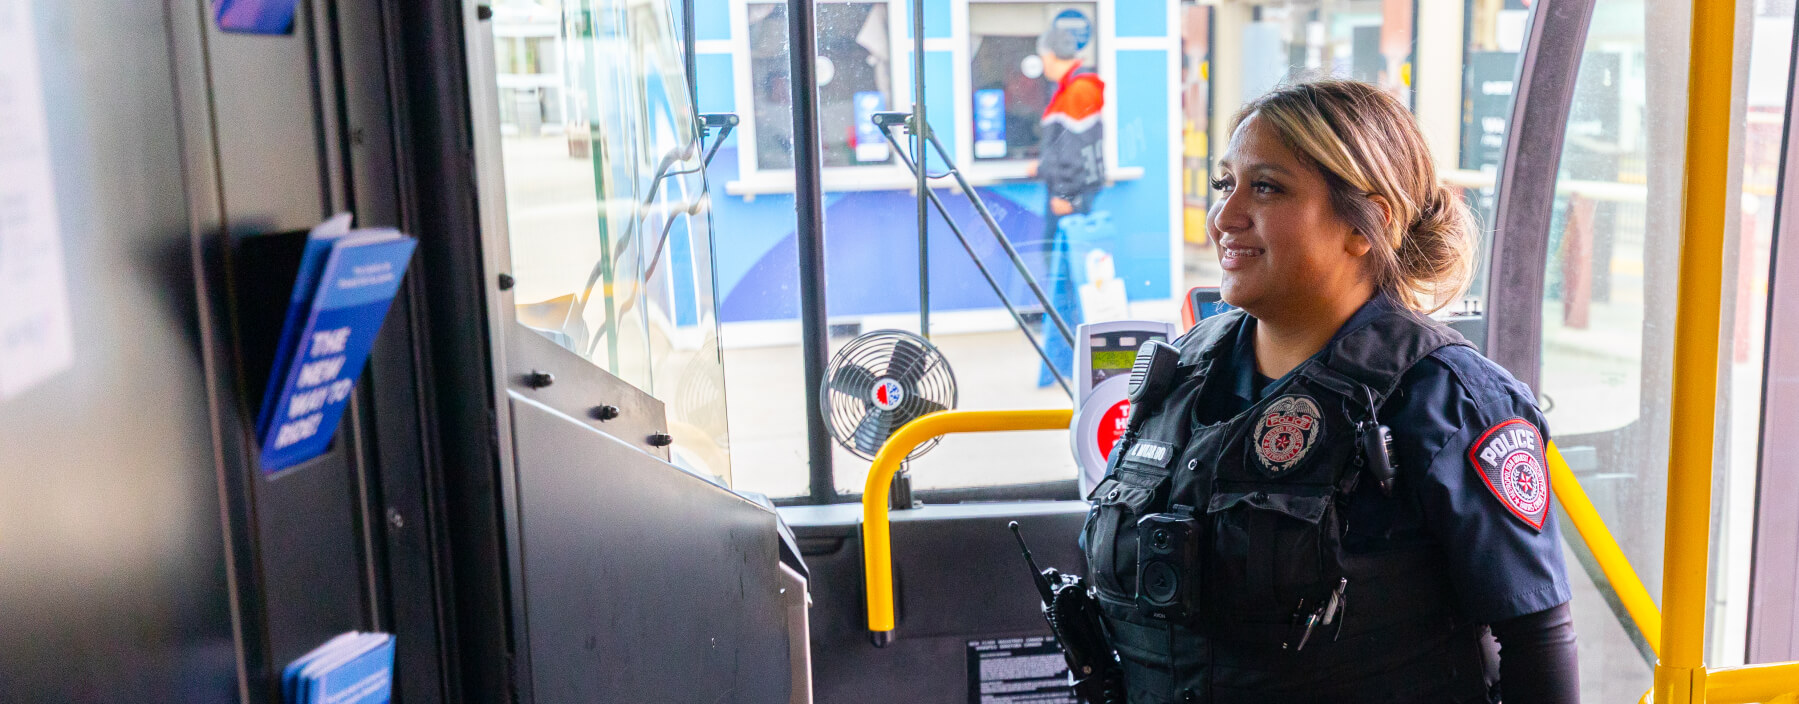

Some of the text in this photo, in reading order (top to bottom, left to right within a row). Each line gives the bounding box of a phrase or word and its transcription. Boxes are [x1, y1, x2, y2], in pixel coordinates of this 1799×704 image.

[311, 325, 351, 359] THE
[297, 354, 347, 389] NEW
[287, 377, 352, 420] WAY TO
[1269, 414, 1312, 430] POLICE
[1480, 428, 1535, 467] POLICE
